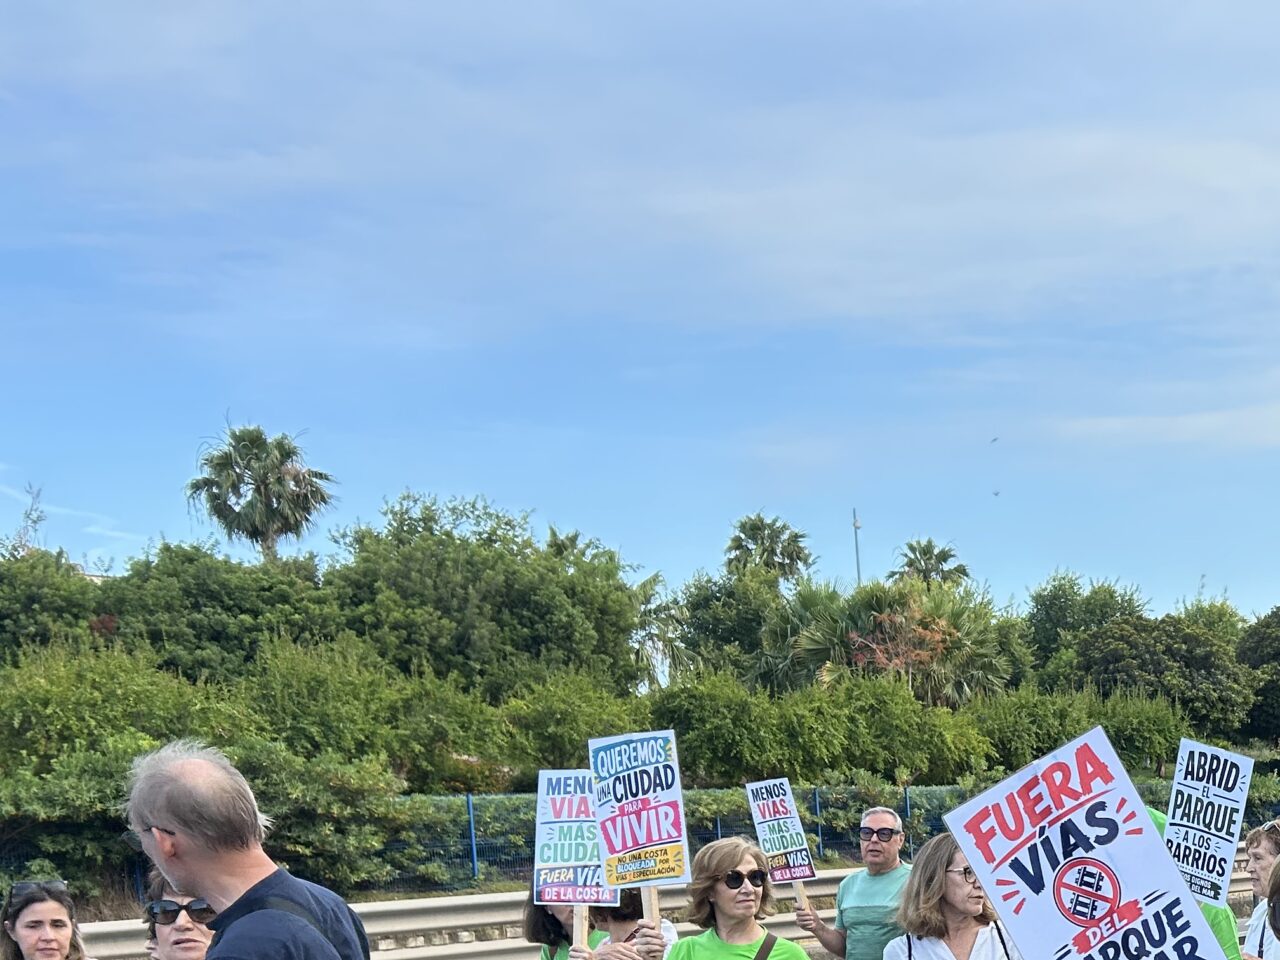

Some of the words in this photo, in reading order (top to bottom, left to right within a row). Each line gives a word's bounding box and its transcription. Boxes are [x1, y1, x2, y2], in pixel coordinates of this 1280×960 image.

[597, 739, 665, 778] QUEREMOS
[1183, 750, 1240, 793] ABRID
[597, 783, 611, 802] UNA
[612, 764, 675, 803] CIUDAD
[751, 783, 787, 803] MENOS
[1201, 786, 1210, 798] EL
[550, 794, 596, 819] VÍA
[624, 800, 642, 814] PARA
[963, 742, 1115, 865] FUERA
[1171, 789, 1240, 838] PARQUE
[558, 823, 597, 841] MÁS
[605, 805, 678, 851] VIVIR
[767, 819, 790, 836] MÁS
[762, 832, 804, 853] CIUDAD
[1008, 800, 1120, 896] VÍAS
[1182, 830, 1189, 843] A
[1192, 834, 1212, 851] LOS
[617, 856, 627, 864] NO
[629, 852, 642, 860] UNA
[644, 848, 668, 859] COSTA
[617, 859, 656, 873] BLOQUEADA
[768, 855, 787, 869] FUERA
[787, 851, 809, 867] VÍAS
[1166, 838, 1227, 877] BARRIOS
[539, 868, 574, 885] FUERA
[632, 865, 675, 879] ESPECULACIÓN
[774, 869, 784, 880] DE
[785, 869, 791, 879] LA
[791, 867, 811, 877] COSTA
[545, 888, 560, 899] DE
[560, 888, 573, 899] LA
[576, 888, 610, 900] COSTA
[1192, 884, 1200, 893] DEL
[1202, 888, 1215, 897] MAR
[1085, 911, 1129, 945] DEL
